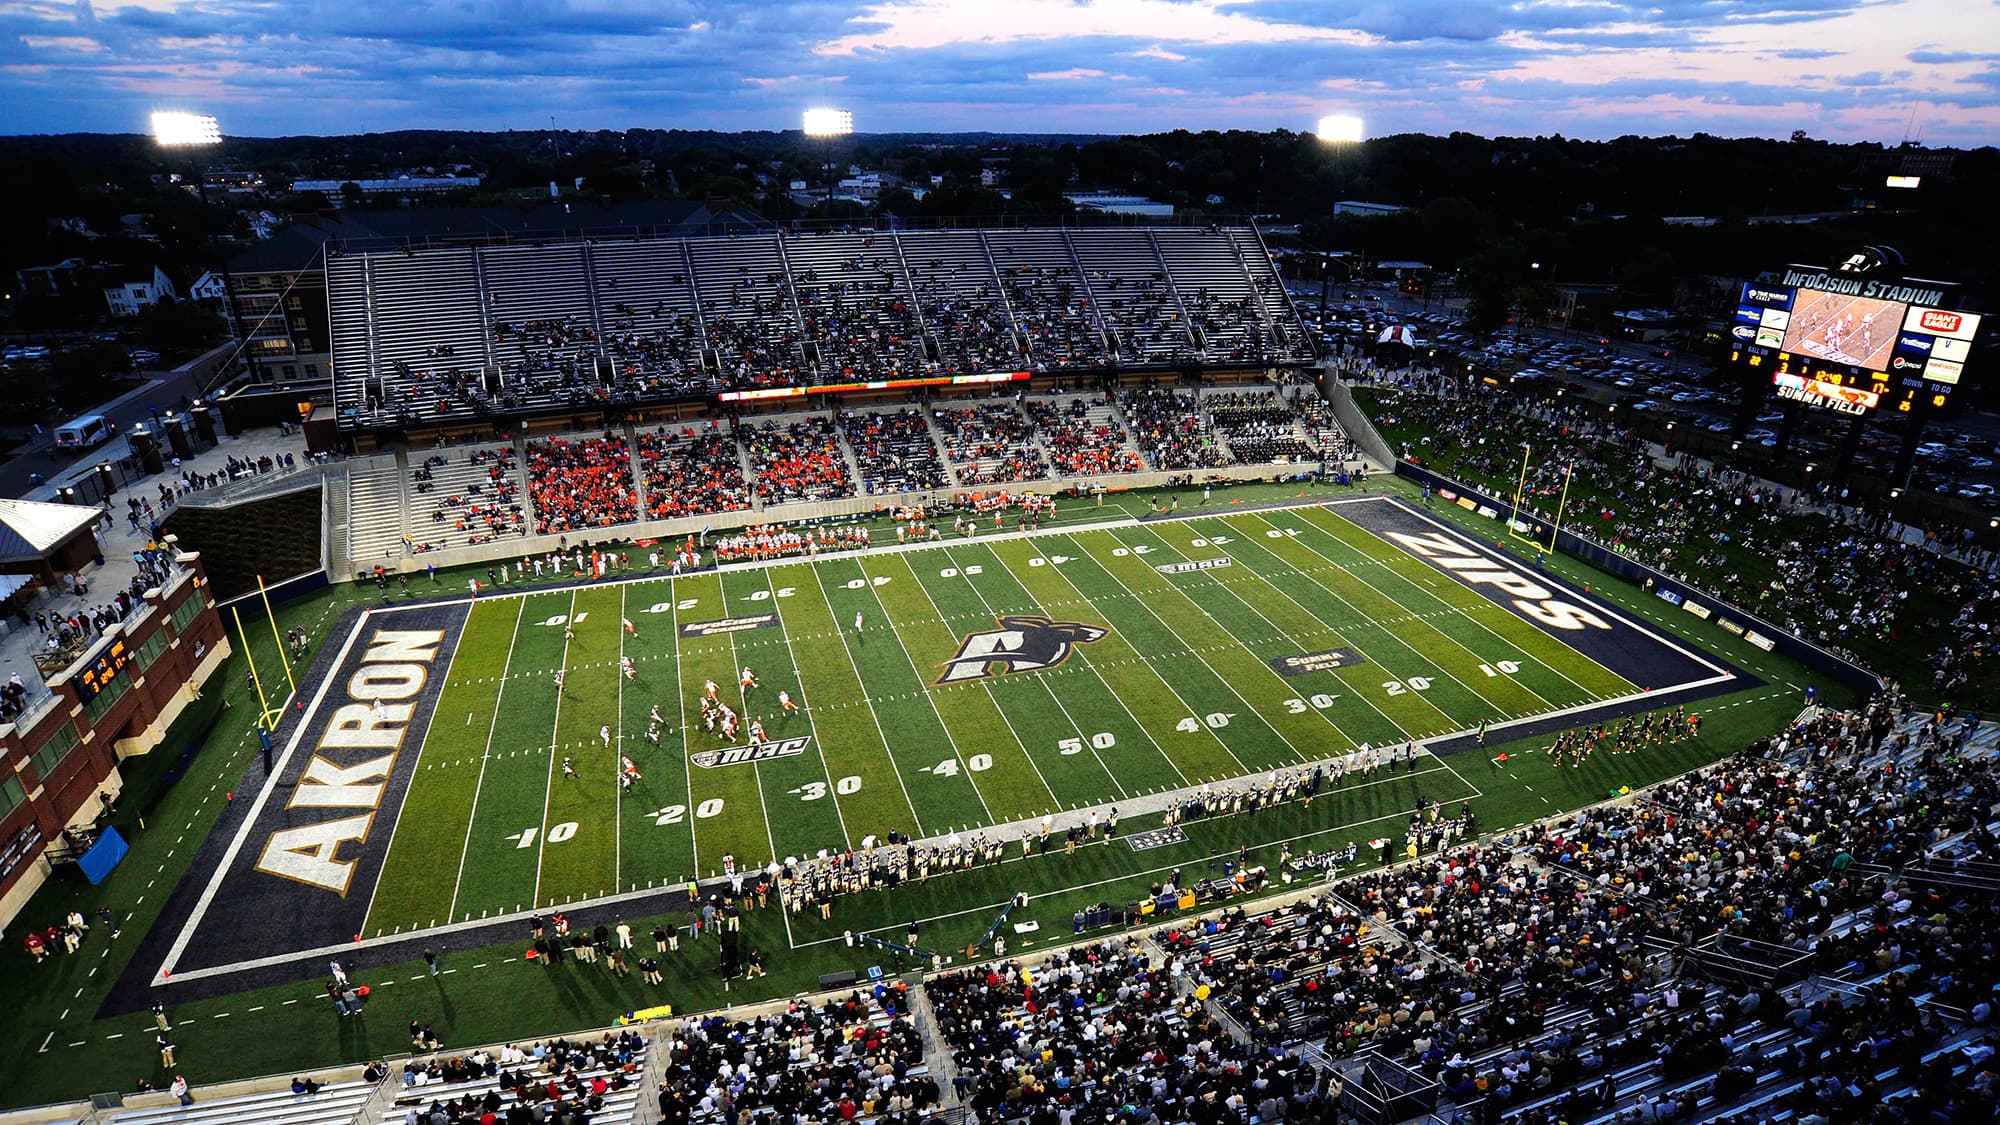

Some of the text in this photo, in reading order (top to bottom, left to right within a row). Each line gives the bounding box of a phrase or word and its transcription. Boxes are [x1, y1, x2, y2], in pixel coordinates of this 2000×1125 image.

[1783, 269, 1944, 306] INFOCISION STADIUM
[1923, 319, 1956, 330] EAGLE
[1924, 313, 1959, 323] GIANT
[1780, 362, 1789, 373] 3
[1902, 377, 1924, 389] DOWN
[1931, 383, 1952, 394] TO GO
[1777, 386, 1867, 415] SUMMA FIELD
[1380, 531, 1613, 630] ZIPS
[1285, 652, 1345, 667] SUMMA
[1304, 660, 1341, 672] FIELD
[1478, 659, 1520, 678] 10
[1382, 676, 1431, 697] 20
[1282, 694, 1334, 714] 30
[1175, 711, 1230, 733] 40
[720, 740, 805, 764] MAC
[1057, 732, 1116, 755] 50
[253, 629, 446, 899] AKRON
[932, 753, 993, 777] 40
[800, 775, 863, 801] 30
[655, 798, 724, 826] 20
[516, 821, 580, 849] 10
